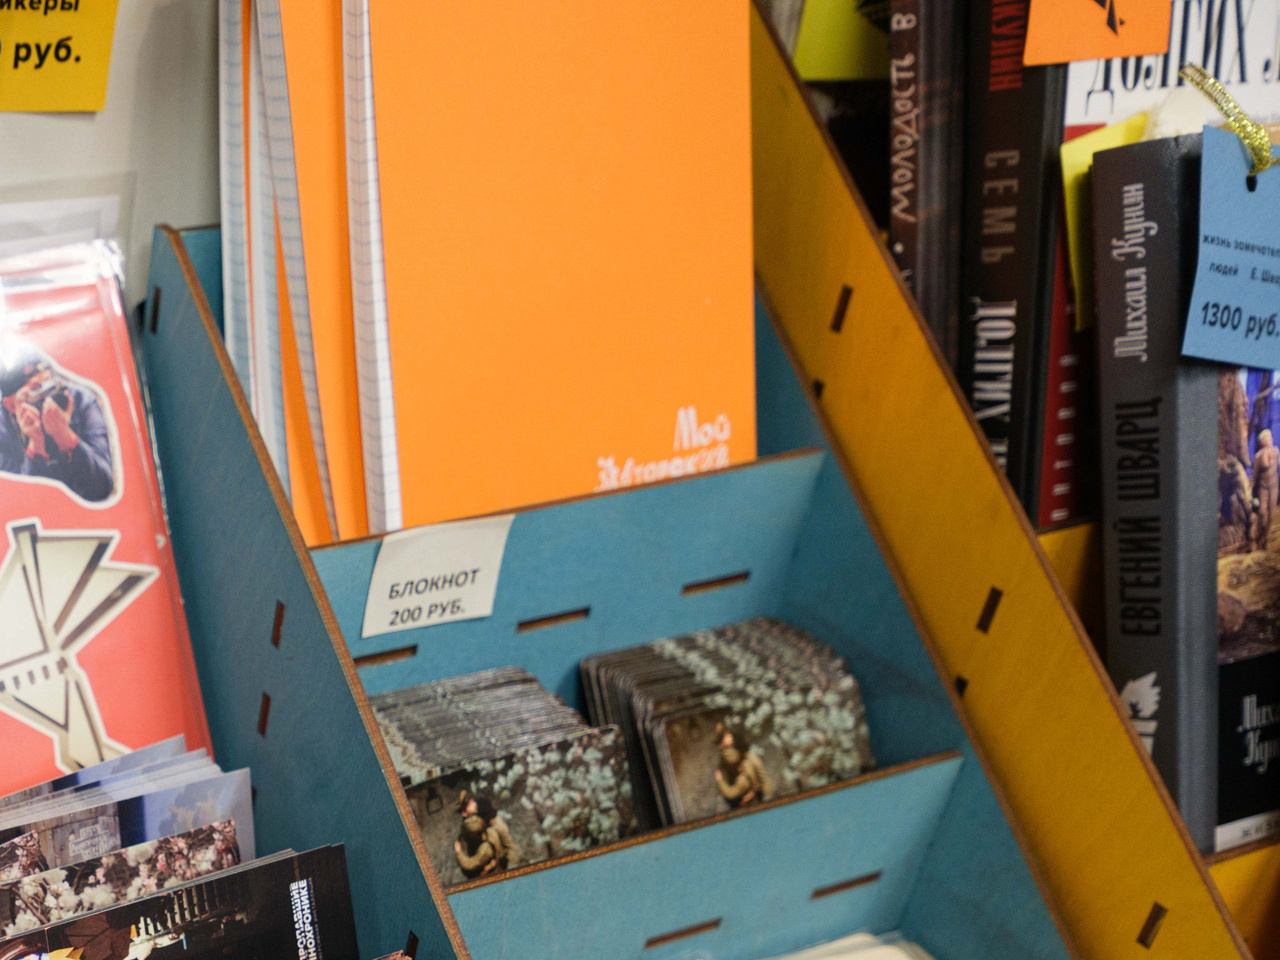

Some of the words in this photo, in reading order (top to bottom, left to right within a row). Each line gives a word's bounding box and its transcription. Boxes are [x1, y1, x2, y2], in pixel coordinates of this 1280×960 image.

[13, 36, 81, 69] руб.
[890, 12, 918, 31] В
[890, 52, 921, 223] МОЛОДОСТЬ
[981, 149, 1020, 264] СЕМЬ
[1111, 182, 1159, 262] Кунин
[1113, 266, 1149, 363] Михаил
[1201, 300, 1243, 331] 1300
[1244, 312, 1280, 341] руб.
[1115, 396, 1163, 501] ШВАРЦ
[389, 567, 481, 600] БЛОКНОТ
[389, 606, 422, 627] 200
[427, 598, 466, 619] РУБ.
[1113, 515, 1162, 637] ЕВГЕНИЙ
